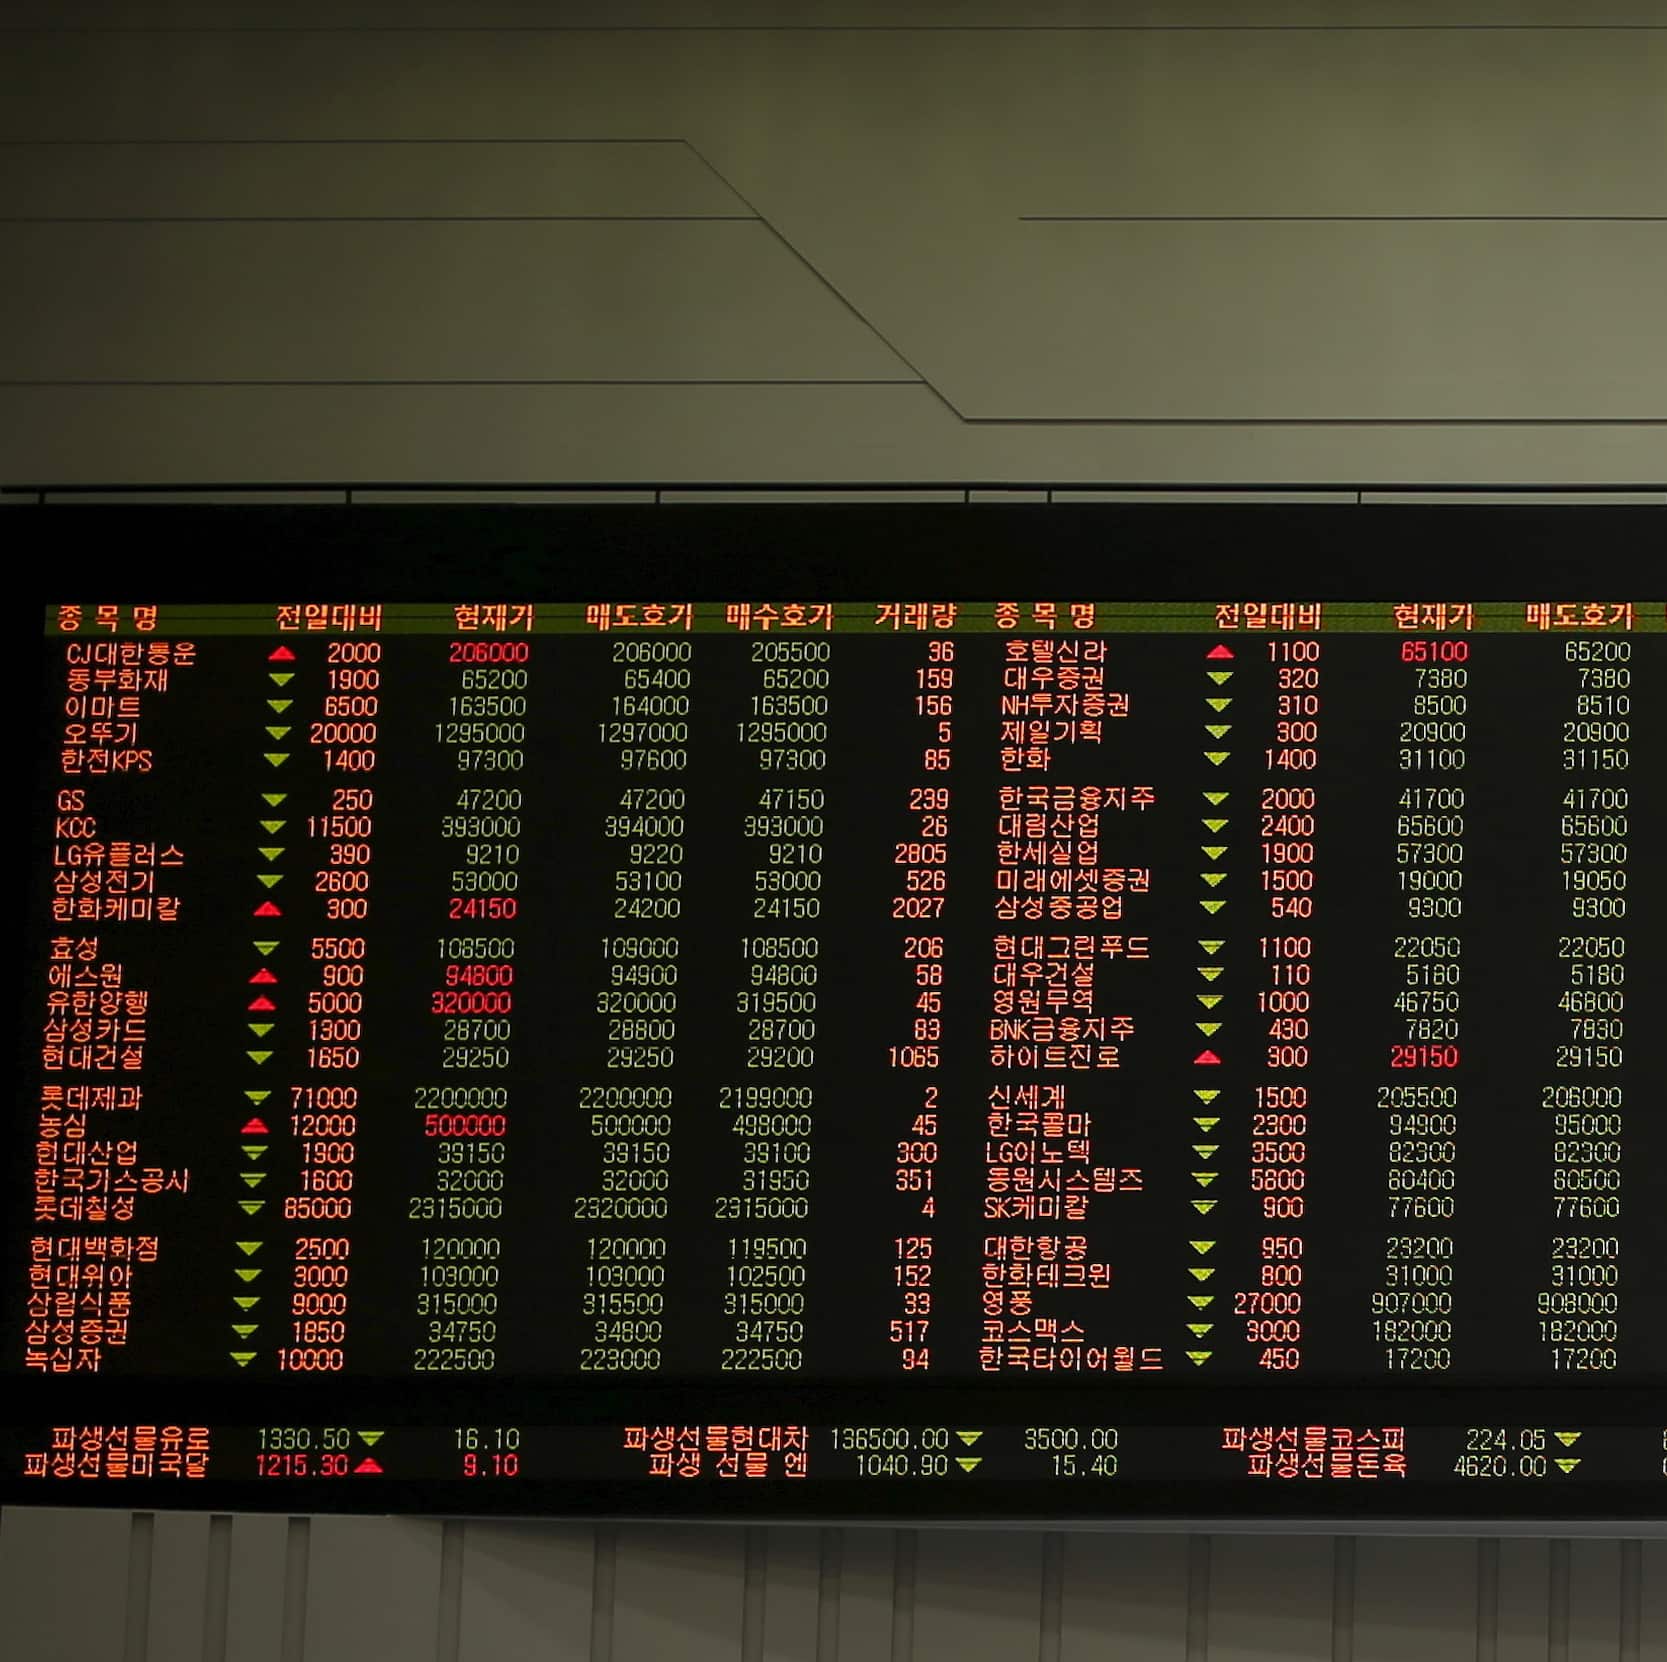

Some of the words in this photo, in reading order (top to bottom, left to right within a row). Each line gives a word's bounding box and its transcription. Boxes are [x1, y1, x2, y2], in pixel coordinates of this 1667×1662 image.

[276, 604, 382, 631] 전일대비
[875, 603, 957, 631] 거래량
[1005, 639, 1108, 664] 호텔신라
[1268, 640, 1320, 663] 1100
[1401, 640, 1469, 663] 65100
[1565, 640, 1631, 662] 65200
[65, 695, 141, 719] 이마트
[324, 695, 379, 717] 6500
[450, 695, 527, 717] 163500
[613, 695, 690, 716] 164000
[751, 695, 828, 716] 163500
[915, 694, 953, 716] 156
[55, 816, 97, 839] KCC
[307, 815, 372, 838] 11500
[441, 815, 521, 838] 393000
[604, 815, 684, 838] 394000
[744, 815, 824, 837] 393000
[921, 814, 948, 838] 26
[996, 841, 1098, 866] 한세실업
[1261, 841, 1314, 864] 1900
[1396, 842, 1463, 864] 57300
[1560, 842, 1628, 864] 57300
[46, 990, 148, 1016] 유한양행
[307, 991, 363, 1014] 5000
[431, 990, 512, 1014] 320000
[596, 991, 677, 1014] 320000
[736, 991, 816, 1013] 319500
[915, 991, 942, 1014] 45
[990, 1044, 1121, 1070] 하이트진로
[1267, 1045, 1309, 1068] 300
[1390, 1044, 1460, 1069] 29150
[1556, 1045, 1623, 1068] 29150
[28, 1263, 134, 1290] 현대위아
[293, 1264, 349, 1288] 3000
[421, 1265, 499, 1288] 103000
[586, 1265, 665, 1288] 103000
[727, 1265, 806, 1288] 102500
[894, 1264, 932, 1287] 152
[978, 1345, 1164, 1372] 한국타이어월드
[1258, 1347, 1300, 1370] 450
[1385, 1347, 1451, 1370] 17200
[1551, 1347, 1617, 1370] 17200
[51, 1425, 210, 1452] 파생선물유로
[259, 1427, 350, 1450] 1330.50
[455, 1427, 520, 1450] 16.10
[623, 1425, 809, 1452] 파생선물현대차
[831, 1427, 949, 1450] 136500.00
[1024, 1427, 1118, 1450] 3500.00
